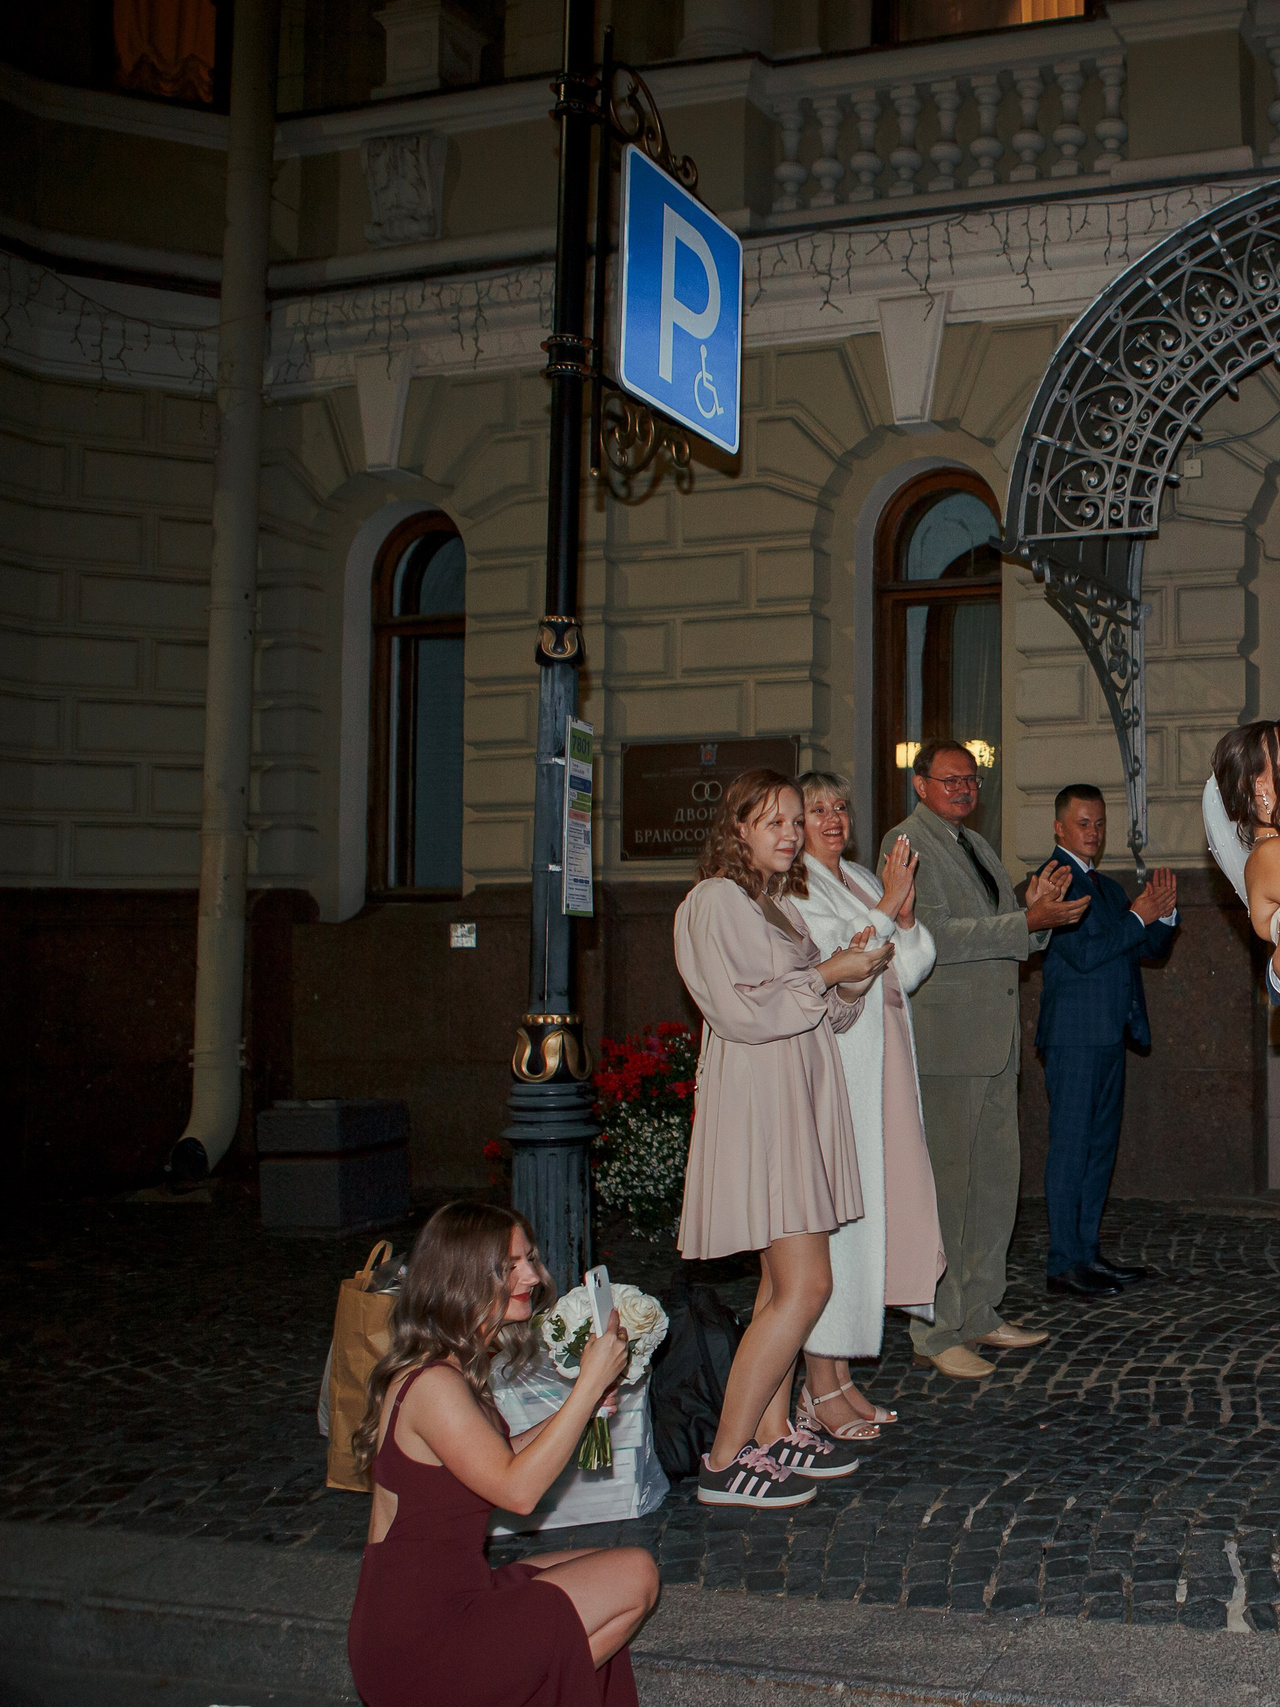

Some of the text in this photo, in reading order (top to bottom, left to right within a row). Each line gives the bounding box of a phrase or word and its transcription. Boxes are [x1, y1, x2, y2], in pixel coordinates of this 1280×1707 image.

[659, 202, 720, 384] P
[571, 734, 591, 757] 7801
[674, 806, 717, 824] ДВОР
[634, 828, 713, 844] БРАКОСО
